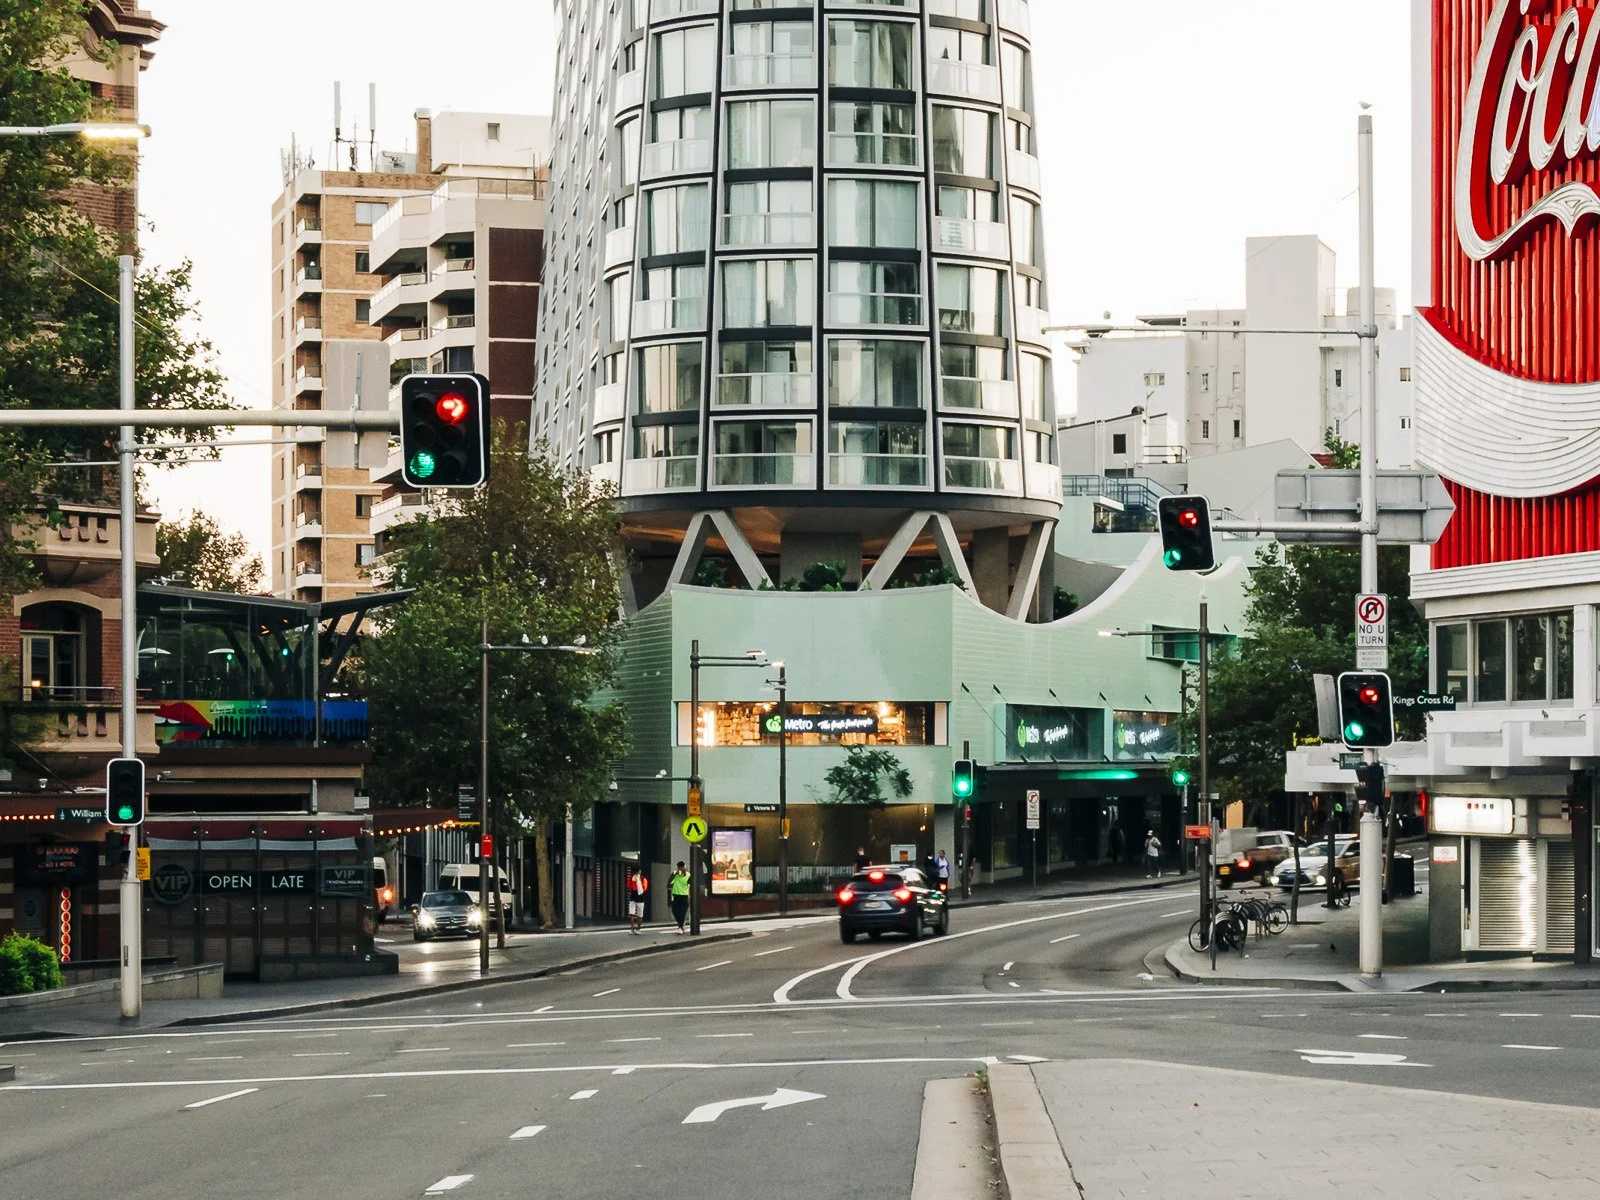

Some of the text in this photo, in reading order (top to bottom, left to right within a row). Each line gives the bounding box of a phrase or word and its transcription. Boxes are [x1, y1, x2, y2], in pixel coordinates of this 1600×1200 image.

[1359, 624, 1385, 635] NO U
[1360, 636, 1384, 645] TURN
[1393, 695, 1454, 707] Kings Cross Rd
[784, 718, 813, 731] Metro
[71, 809, 102, 818] William
[334, 869, 355, 879] VIP
[156, 875, 189, 890] VIP
[209, 875, 304, 888] OPEN LATE
